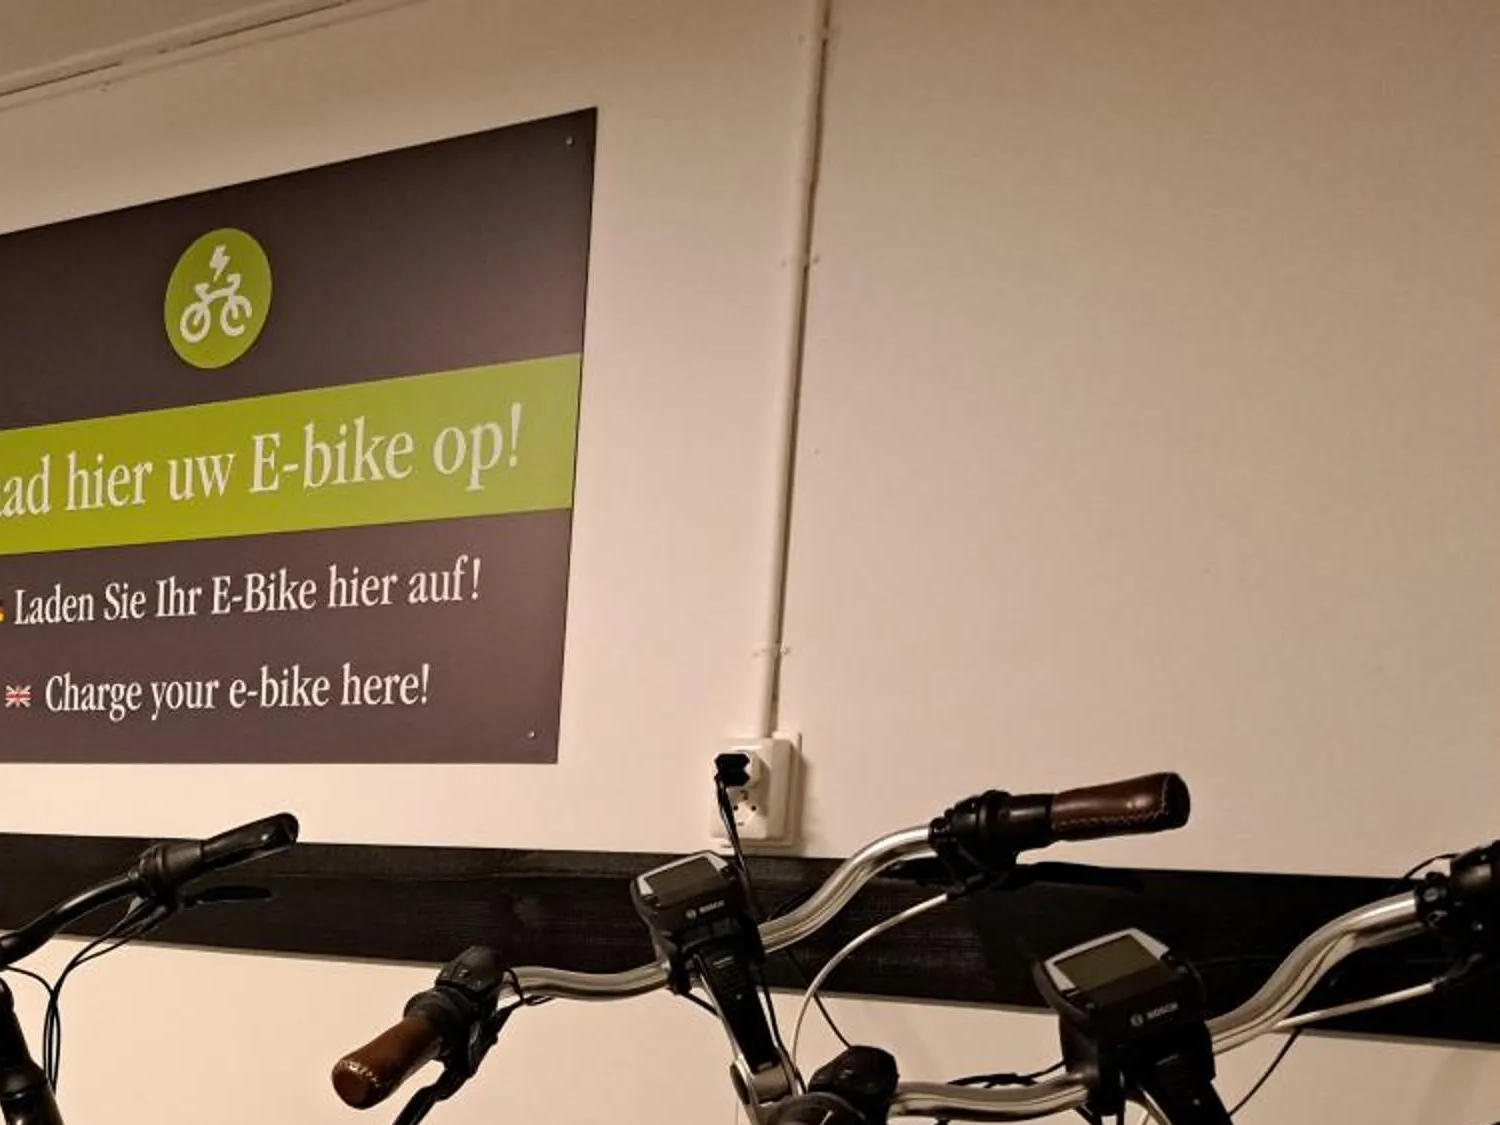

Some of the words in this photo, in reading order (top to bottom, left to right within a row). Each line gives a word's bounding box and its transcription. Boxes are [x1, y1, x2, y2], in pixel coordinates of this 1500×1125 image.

[66, 451, 153, 512] hier
[168, 453, 236, 501] uw
[250, 416, 414, 493] E-bike
[433, 402, 522, 491] op!
[14, 582, 95, 625] Laden
[103, 581, 146, 621] Sie
[156, 575, 203, 617] Ihr
[211, 567, 317, 615] E-Bike
[328, 564, 398, 608] hier
[408, 555, 482, 604] auf!
[45, 672, 142, 722] Charge
[150, 680, 220, 721] your
[229, 664, 330, 709] e-bike
[340, 662, 431, 706] here!
